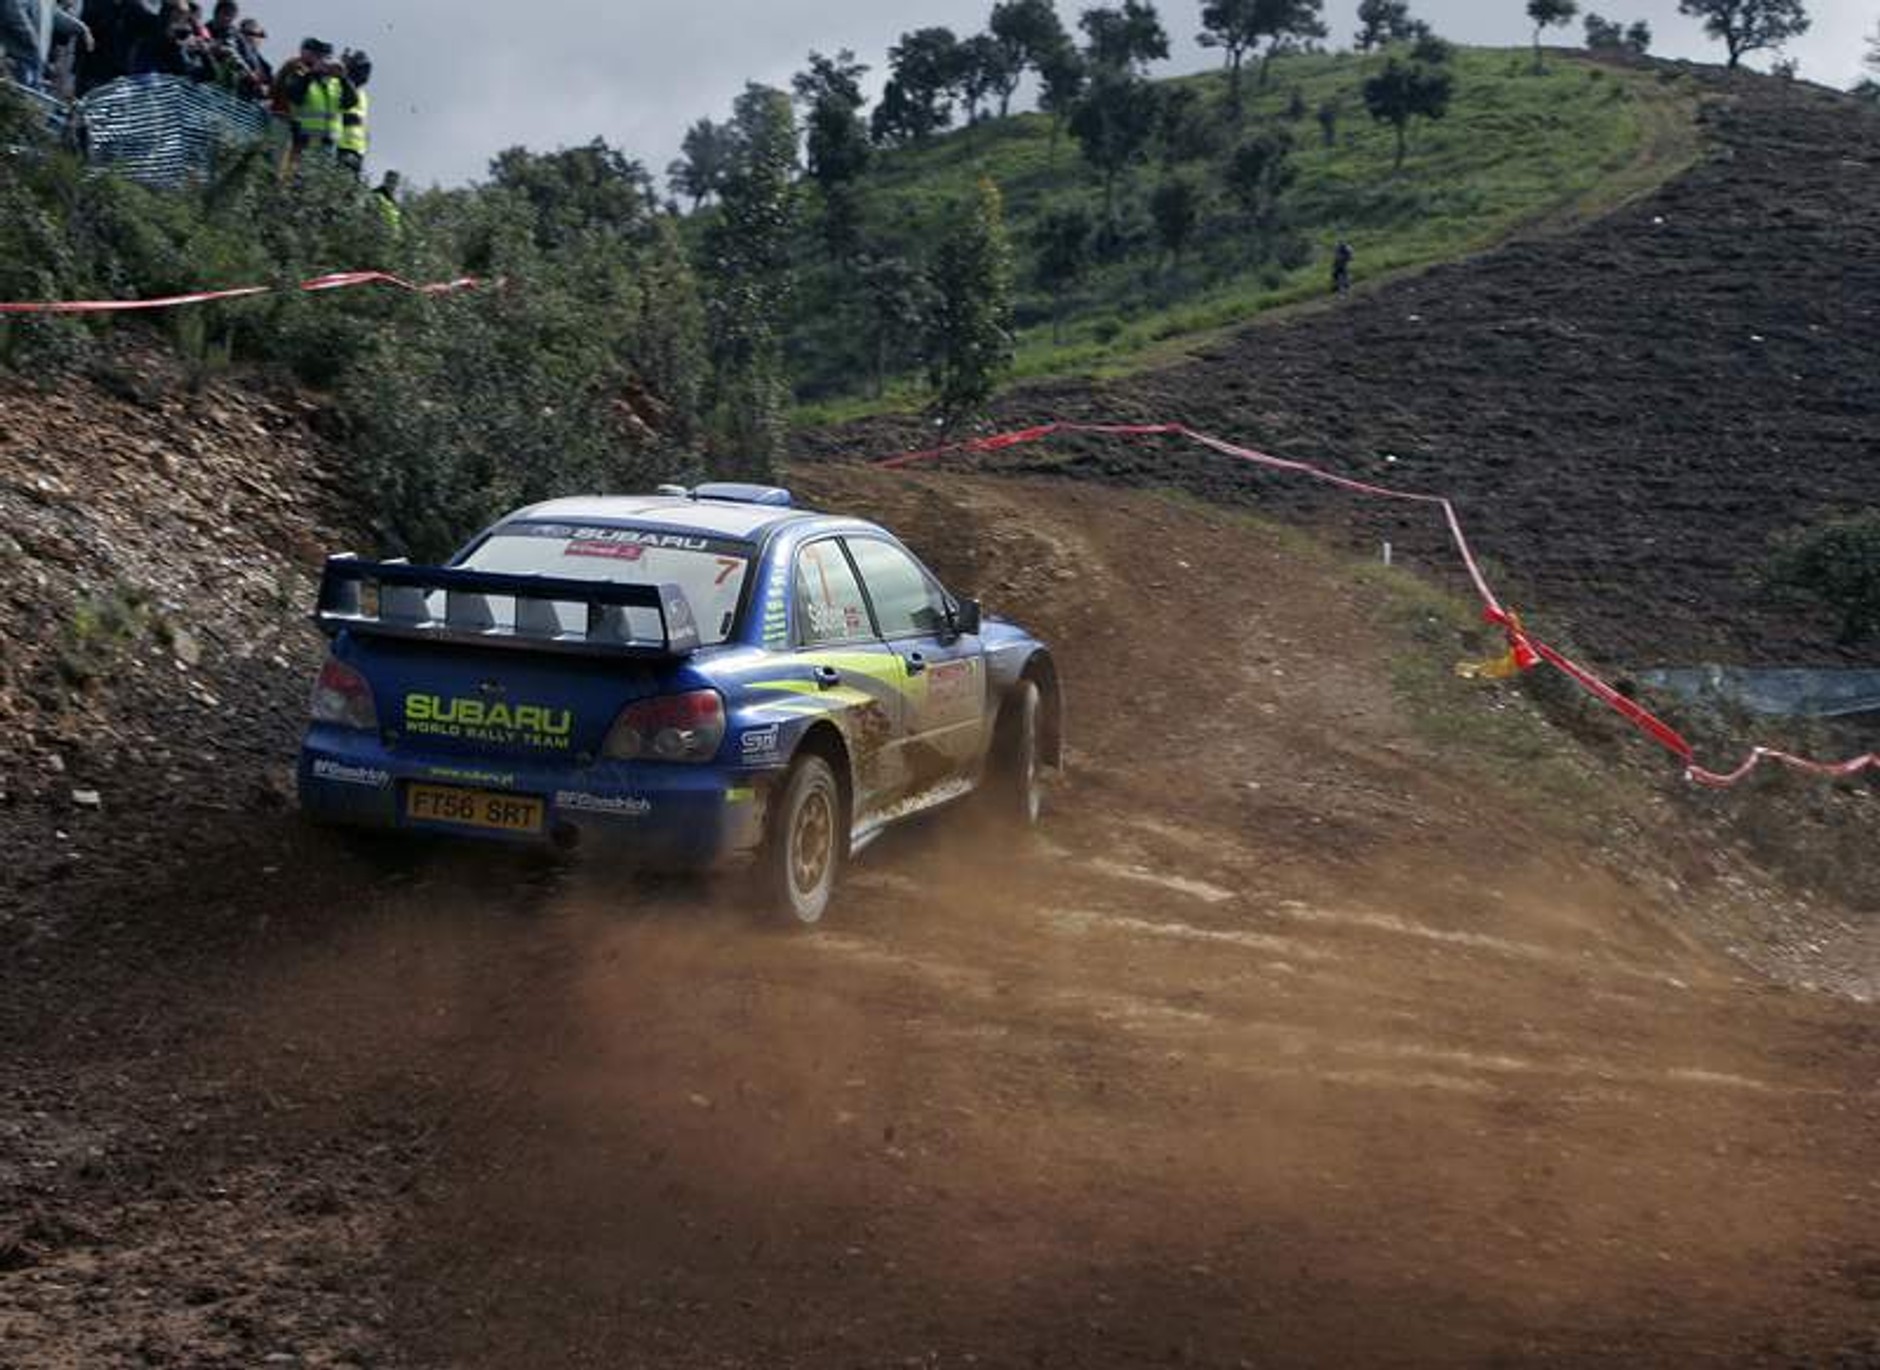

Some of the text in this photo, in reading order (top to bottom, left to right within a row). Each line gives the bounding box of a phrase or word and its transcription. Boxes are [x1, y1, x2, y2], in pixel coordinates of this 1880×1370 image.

[573, 526, 708, 549] SUBARU
[714, 558, 741, 585] 7
[406, 692, 571, 735] SUBARU
[406, 721, 570, 749] WORLD RALLY TEAM
[414, 790, 537, 829] FT56 SRT
